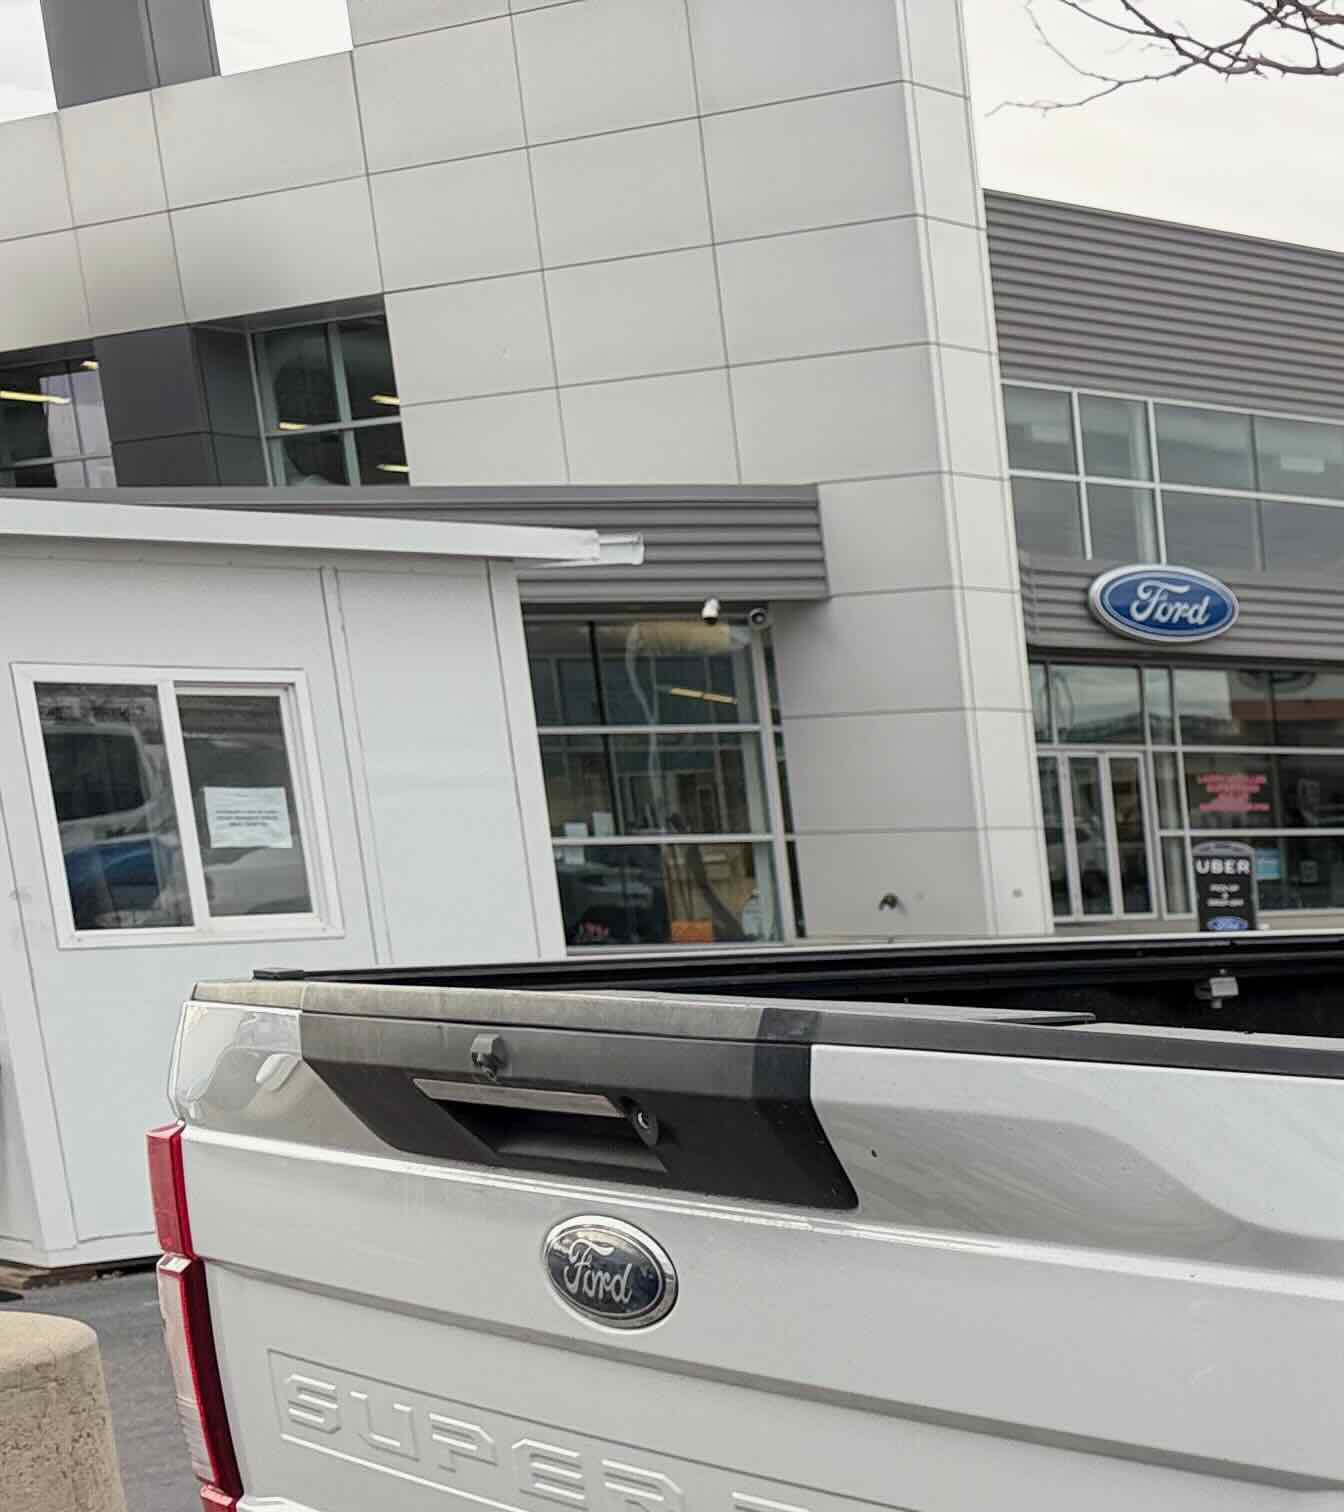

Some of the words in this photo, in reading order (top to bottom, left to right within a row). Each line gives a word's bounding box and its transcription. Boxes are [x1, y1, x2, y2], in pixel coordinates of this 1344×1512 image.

[1129, 579, 1211, 625] Ford
[1195, 858, 1251, 875] UBER
[563, 1238, 634, 1305] Ford
